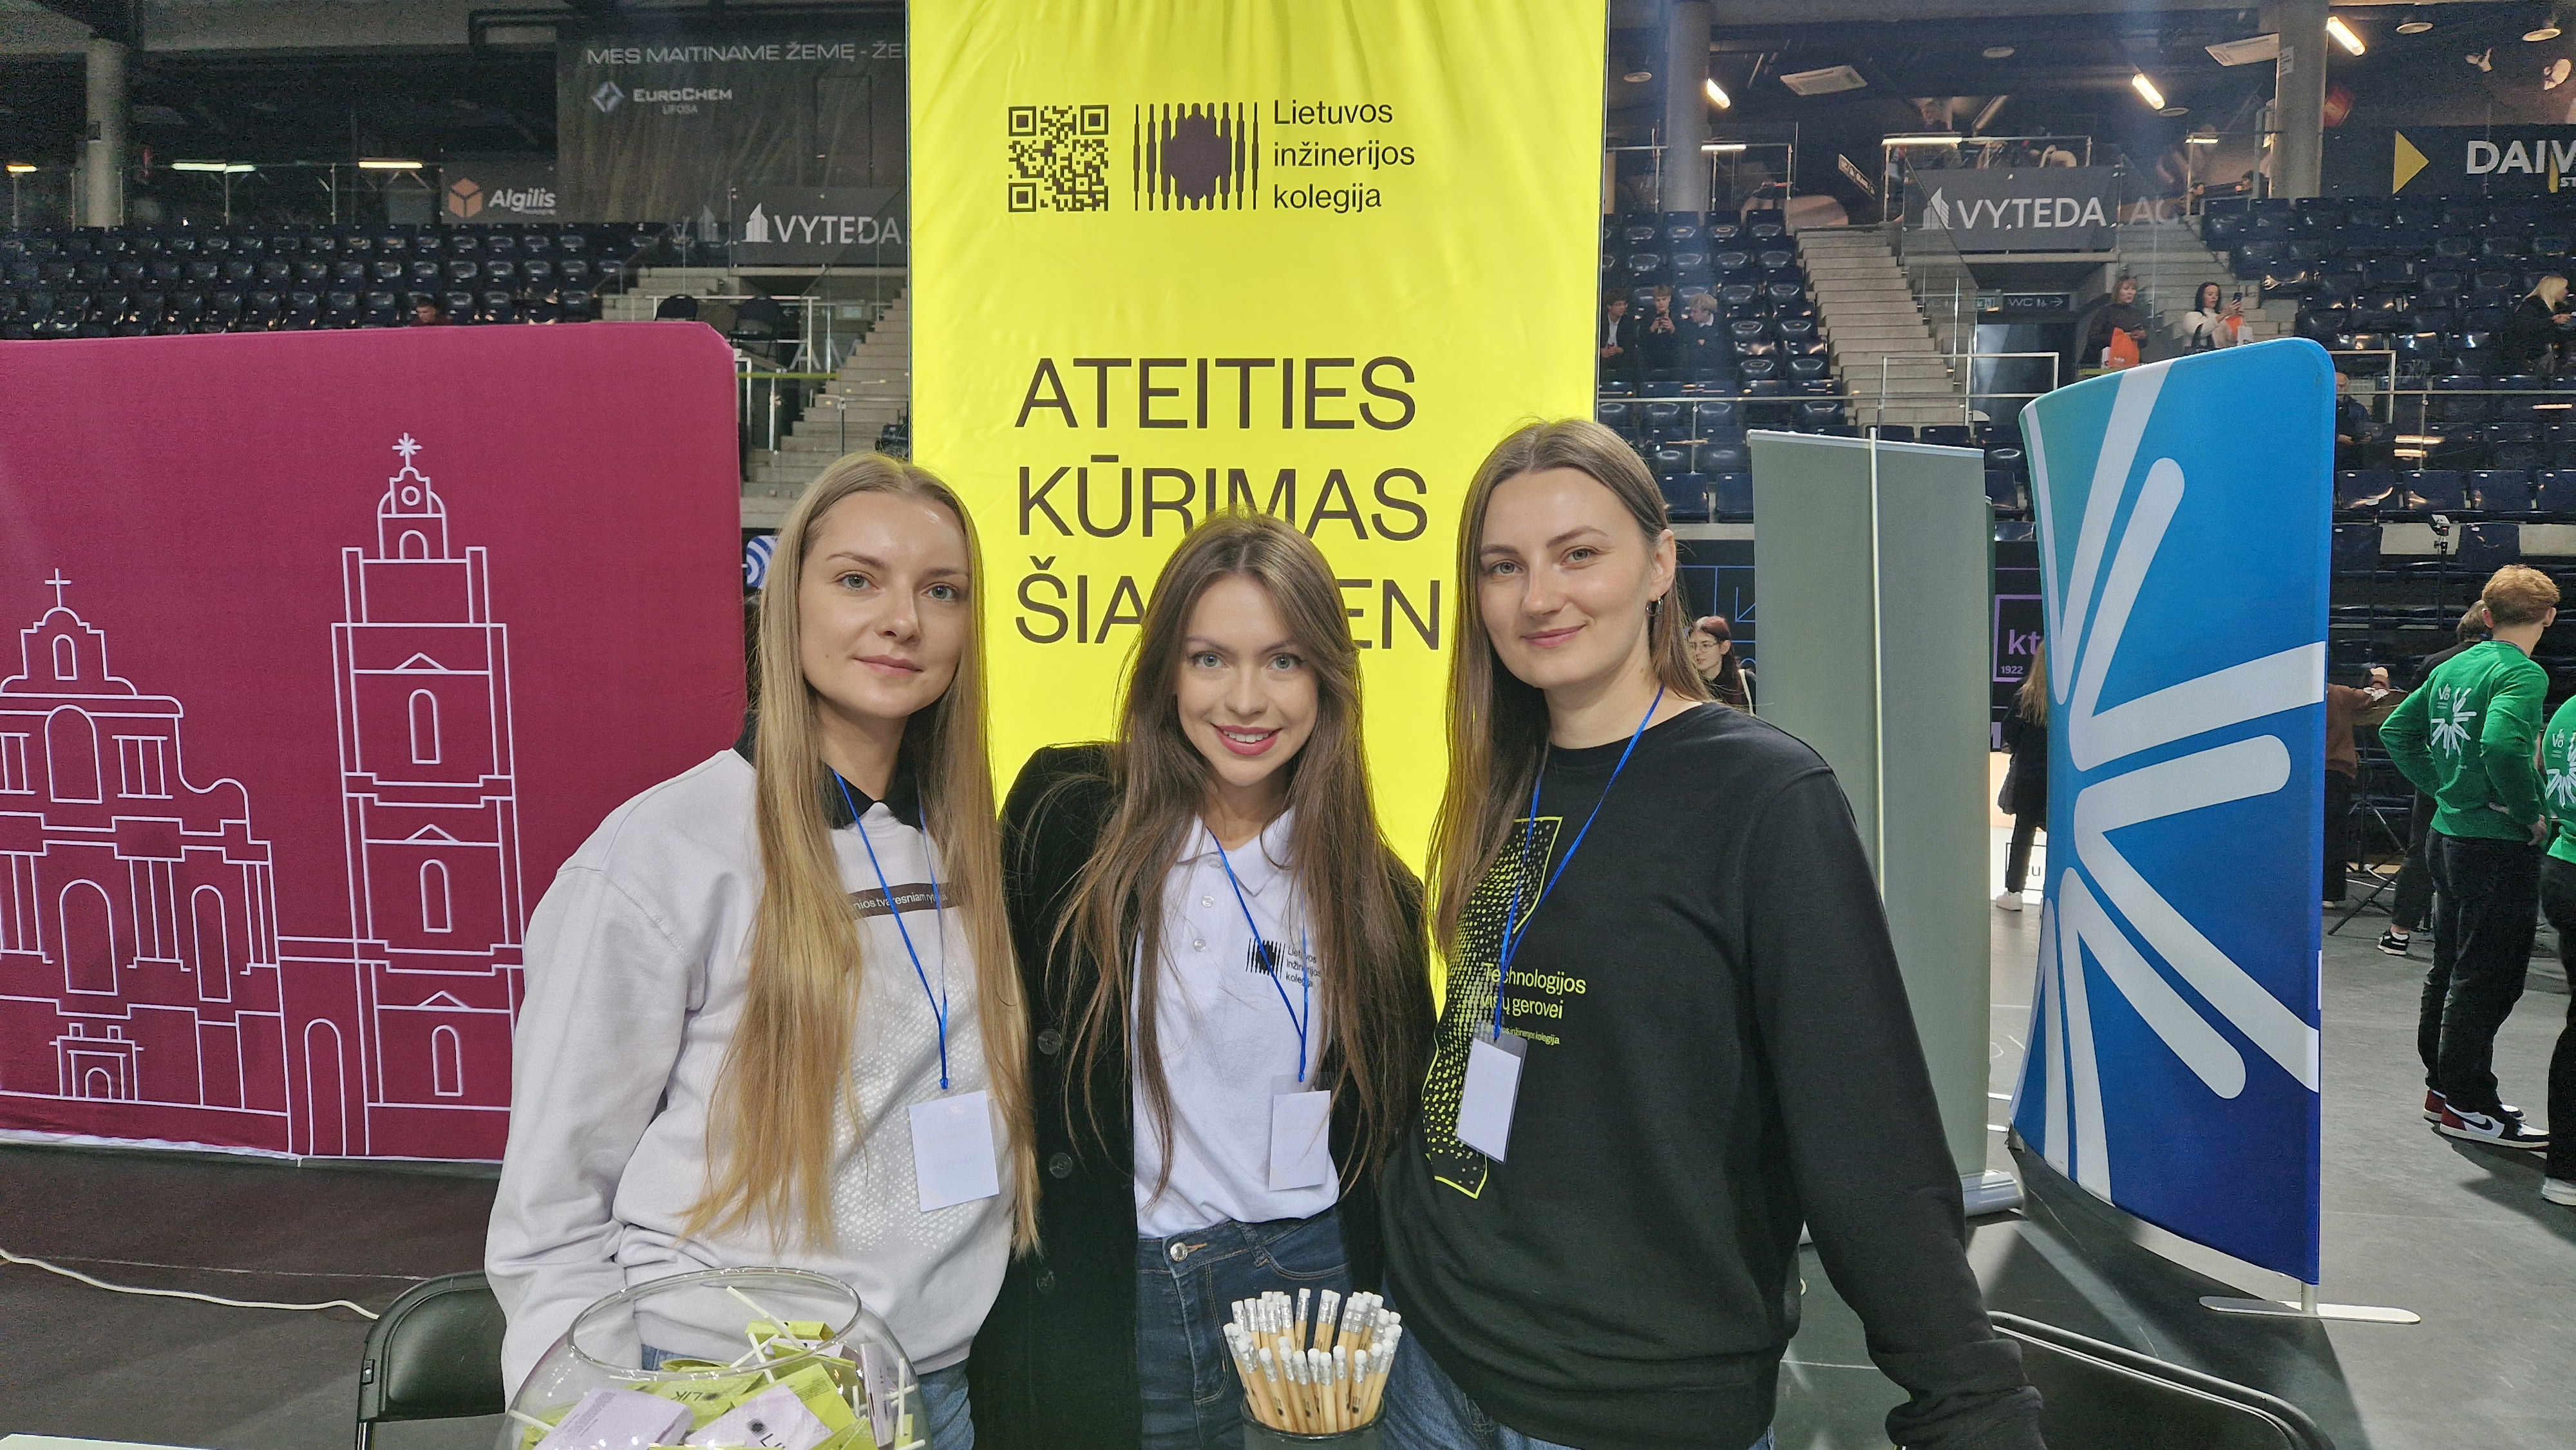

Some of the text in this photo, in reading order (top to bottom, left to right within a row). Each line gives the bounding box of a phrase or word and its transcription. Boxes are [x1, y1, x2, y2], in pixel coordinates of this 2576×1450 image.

[587, 47, 641, 64] MES
[646, 44, 779, 62] MAITINAME
[786, 41, 855, 62] ŽEMĘ
[1274, 99, 1393, 125] Lietuvos
[1274, 140, 1415, 171] inžinerijos
[488, 187, 556, 212] Algilis
[1274, 183, 1382, 214] kolegija
[1956, 196, 2107, 229] VYTEDA
[774, 215, 902, 244] VYTEDA
[2008, 297, 2033, 307] WC
[1014, 356, 1417, 431] ATEITIES
[1019, 454, 1428, 542] KŪRIMAS
[1016, 555, 1440, 650] ŠIAEN
[2000, 665, 2023, 674] 1922
[1288, 945, 1317, 964] Lietos
[1285, 971, 1313, 988] kolega
[1286, 958, 1321, 977] inžinrijos
[1512, 998, 1564, 1019] gerovei
[670, 1391, 704, 1401] LIK
